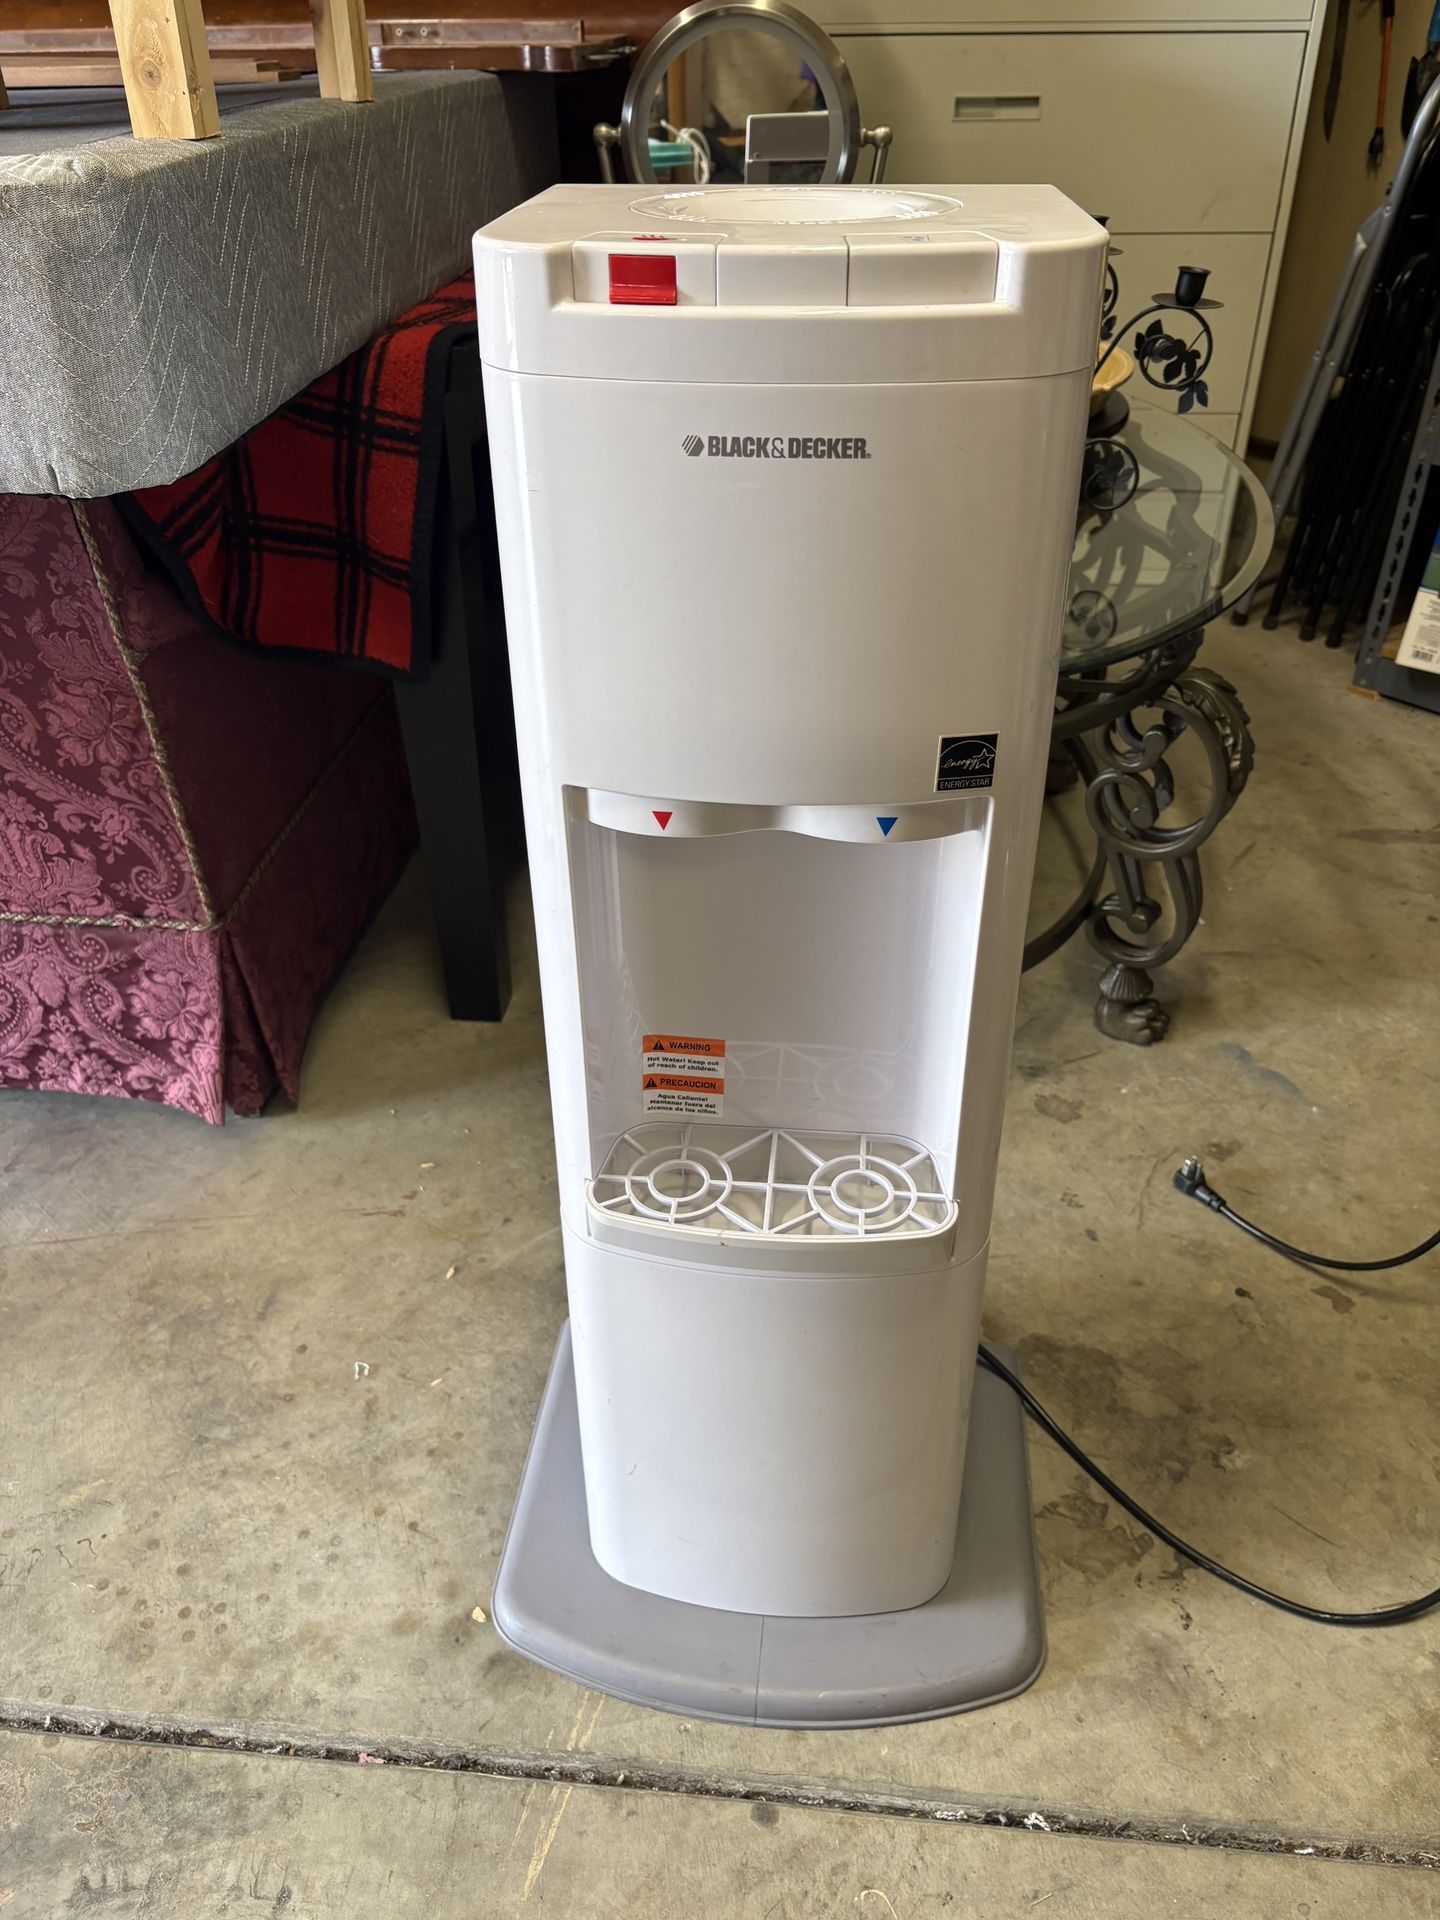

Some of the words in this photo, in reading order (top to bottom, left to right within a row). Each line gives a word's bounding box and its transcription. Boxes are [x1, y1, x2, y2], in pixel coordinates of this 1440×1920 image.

[940, 780, 970, 789] ENERGY
[970, 777, 990, 787] STAR
[669, 1041, 710, 1051] WARNING
[660, 1078, 716, 1089] PRECAUCION
